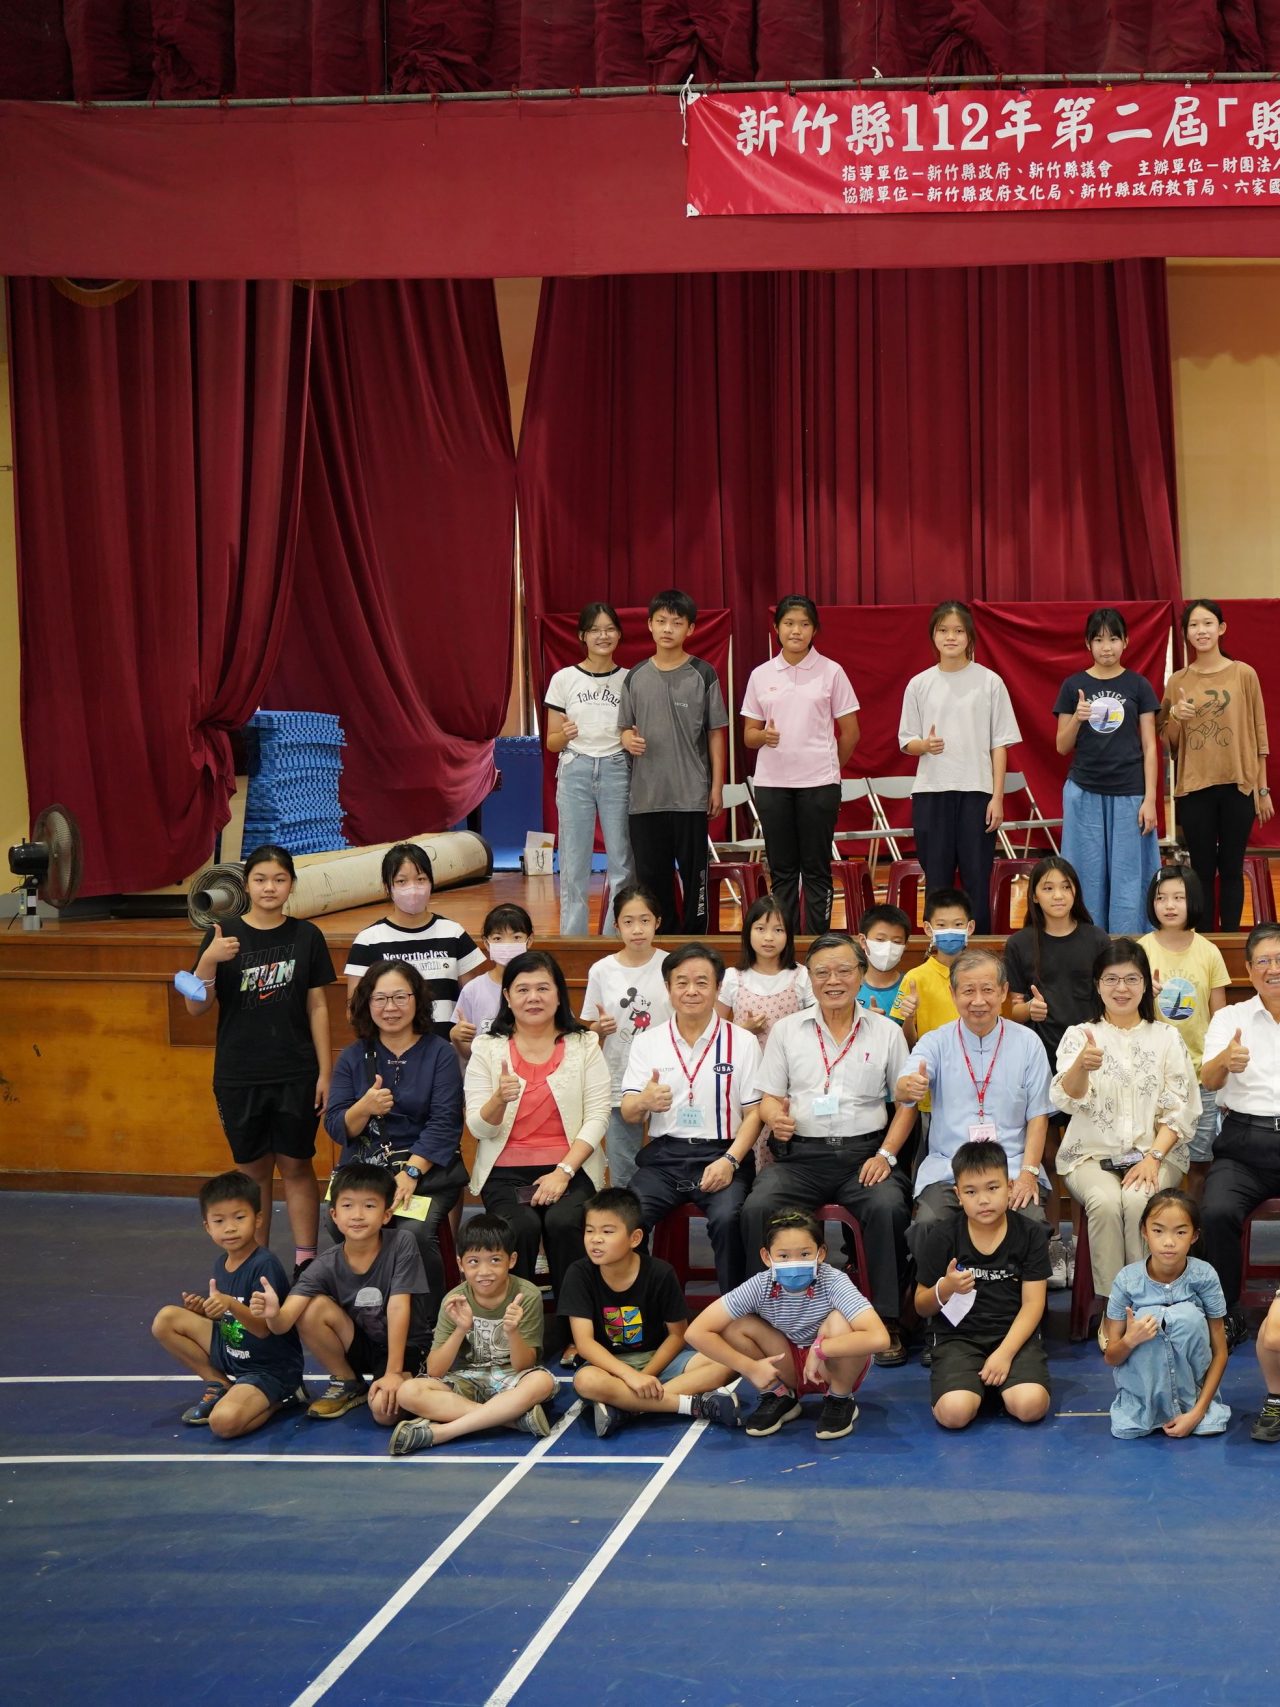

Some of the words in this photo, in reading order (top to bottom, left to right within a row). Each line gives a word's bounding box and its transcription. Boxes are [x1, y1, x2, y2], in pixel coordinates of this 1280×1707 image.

[577, 689, 600, 704] Take
[382, 949, 449, 961] Nevertheless
[240, 959, 296, 992] RUN
